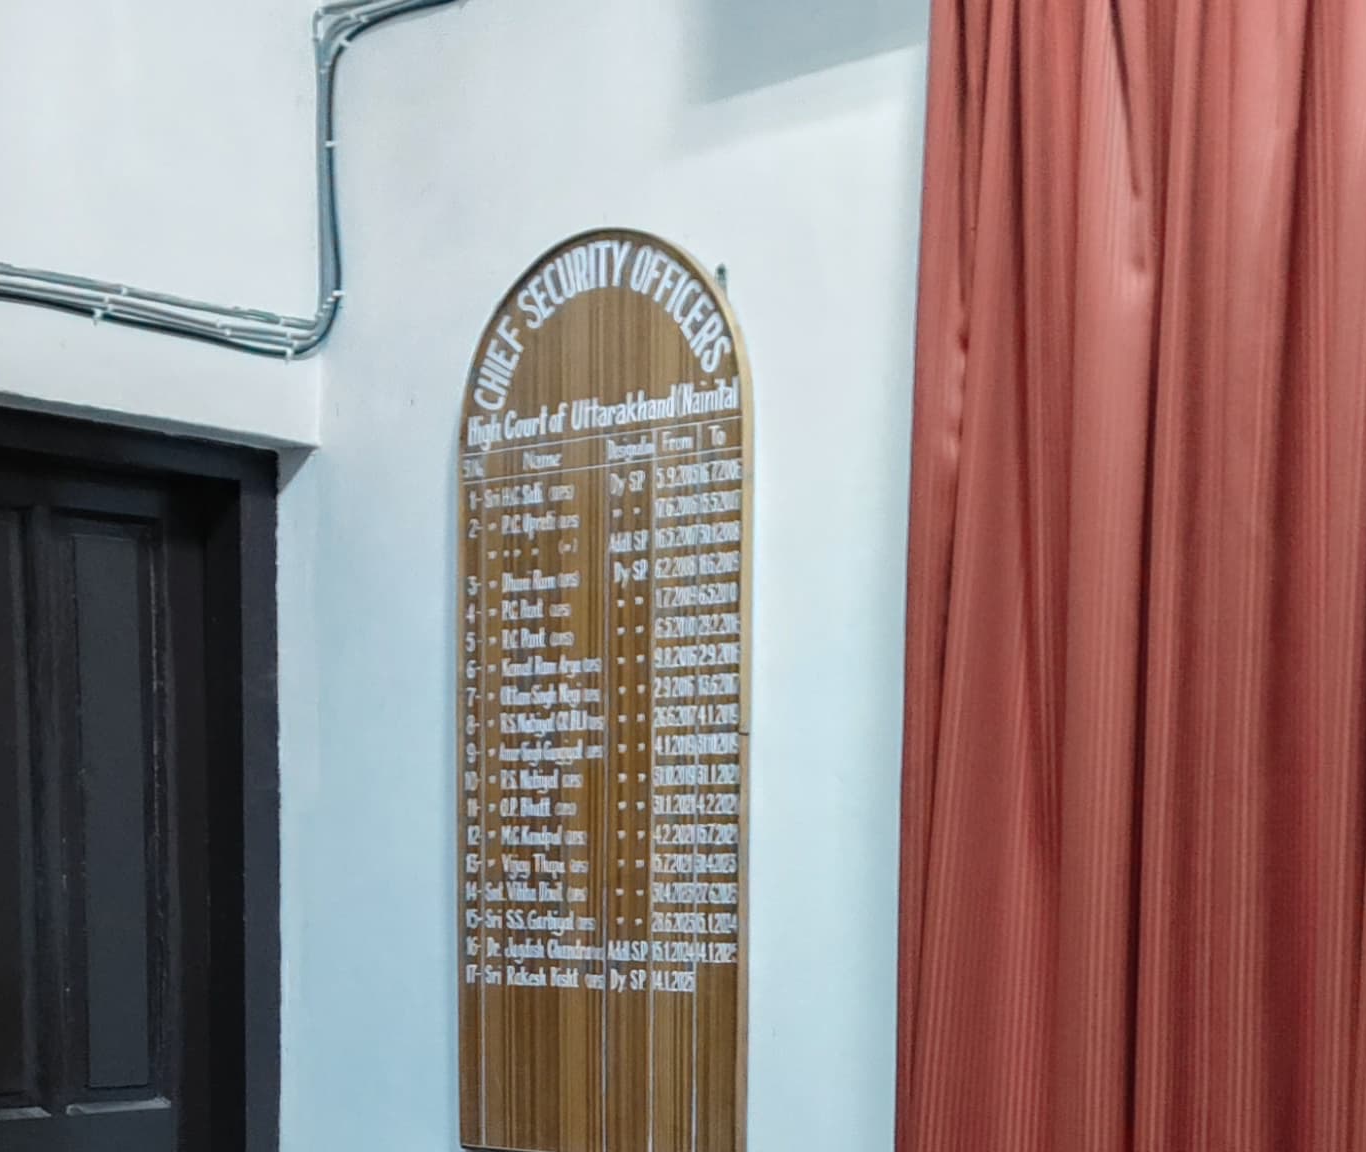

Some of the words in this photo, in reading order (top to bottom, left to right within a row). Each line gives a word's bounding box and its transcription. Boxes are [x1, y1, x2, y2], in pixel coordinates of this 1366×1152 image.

[474, 315, 524, 411] CHIEF
[517, 240, 632, 329] SECURITY
[633, 245, 732, 373] OFFICERS
[468, 415, 502, 451] High
[504, 405, 548, 440] Court
[549, 402, 569, 433] of
[661, 431, 694, 451] From
[707, 424, 727, 446] To
